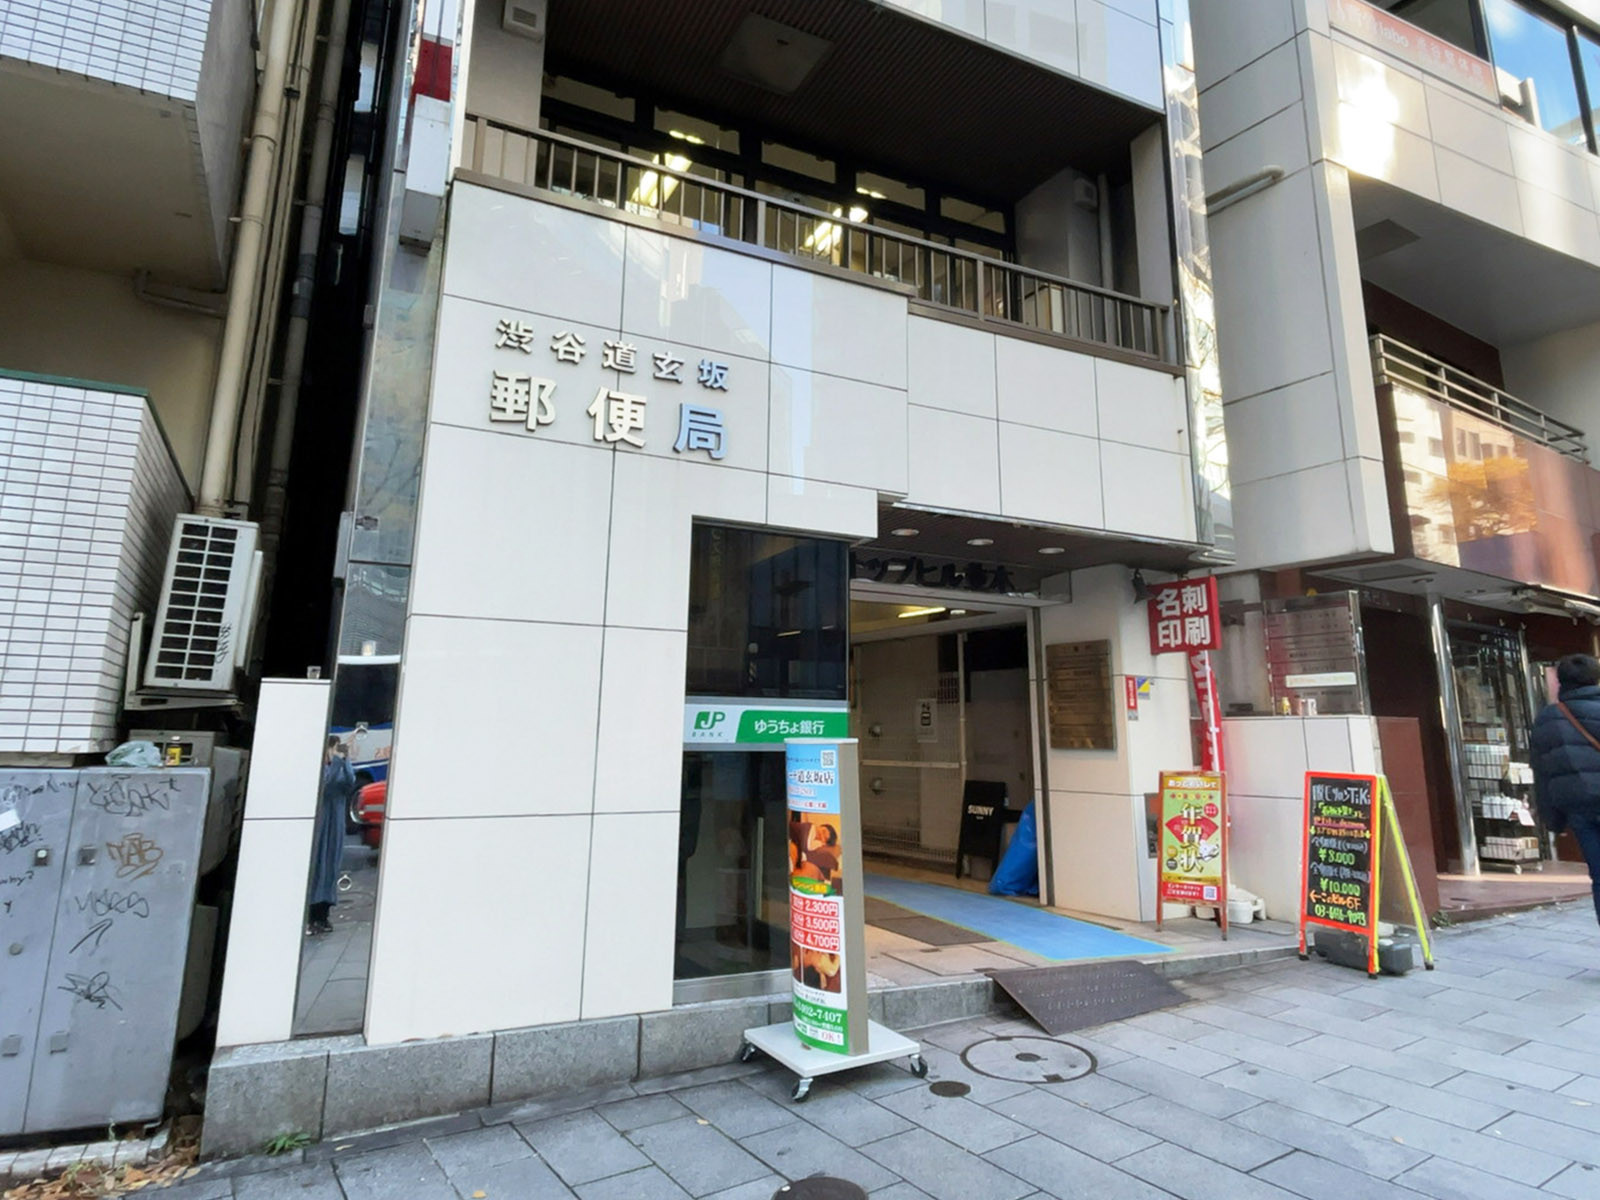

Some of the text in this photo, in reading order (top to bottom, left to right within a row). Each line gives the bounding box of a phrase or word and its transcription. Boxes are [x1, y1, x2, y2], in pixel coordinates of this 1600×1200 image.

[496, 318, 729, 392] 渋谷道玄坂
[490, 369, 729, 460] 郵便局
[1156, 583, 1209, 618] 名刺
[1157, 615, 1211, 648] 印刷
[694, 711, 726, 730] JP
[754, 719, 825, 735] ゆうちょ銀行
[1181, 803, 1204, 873] 年賀状
